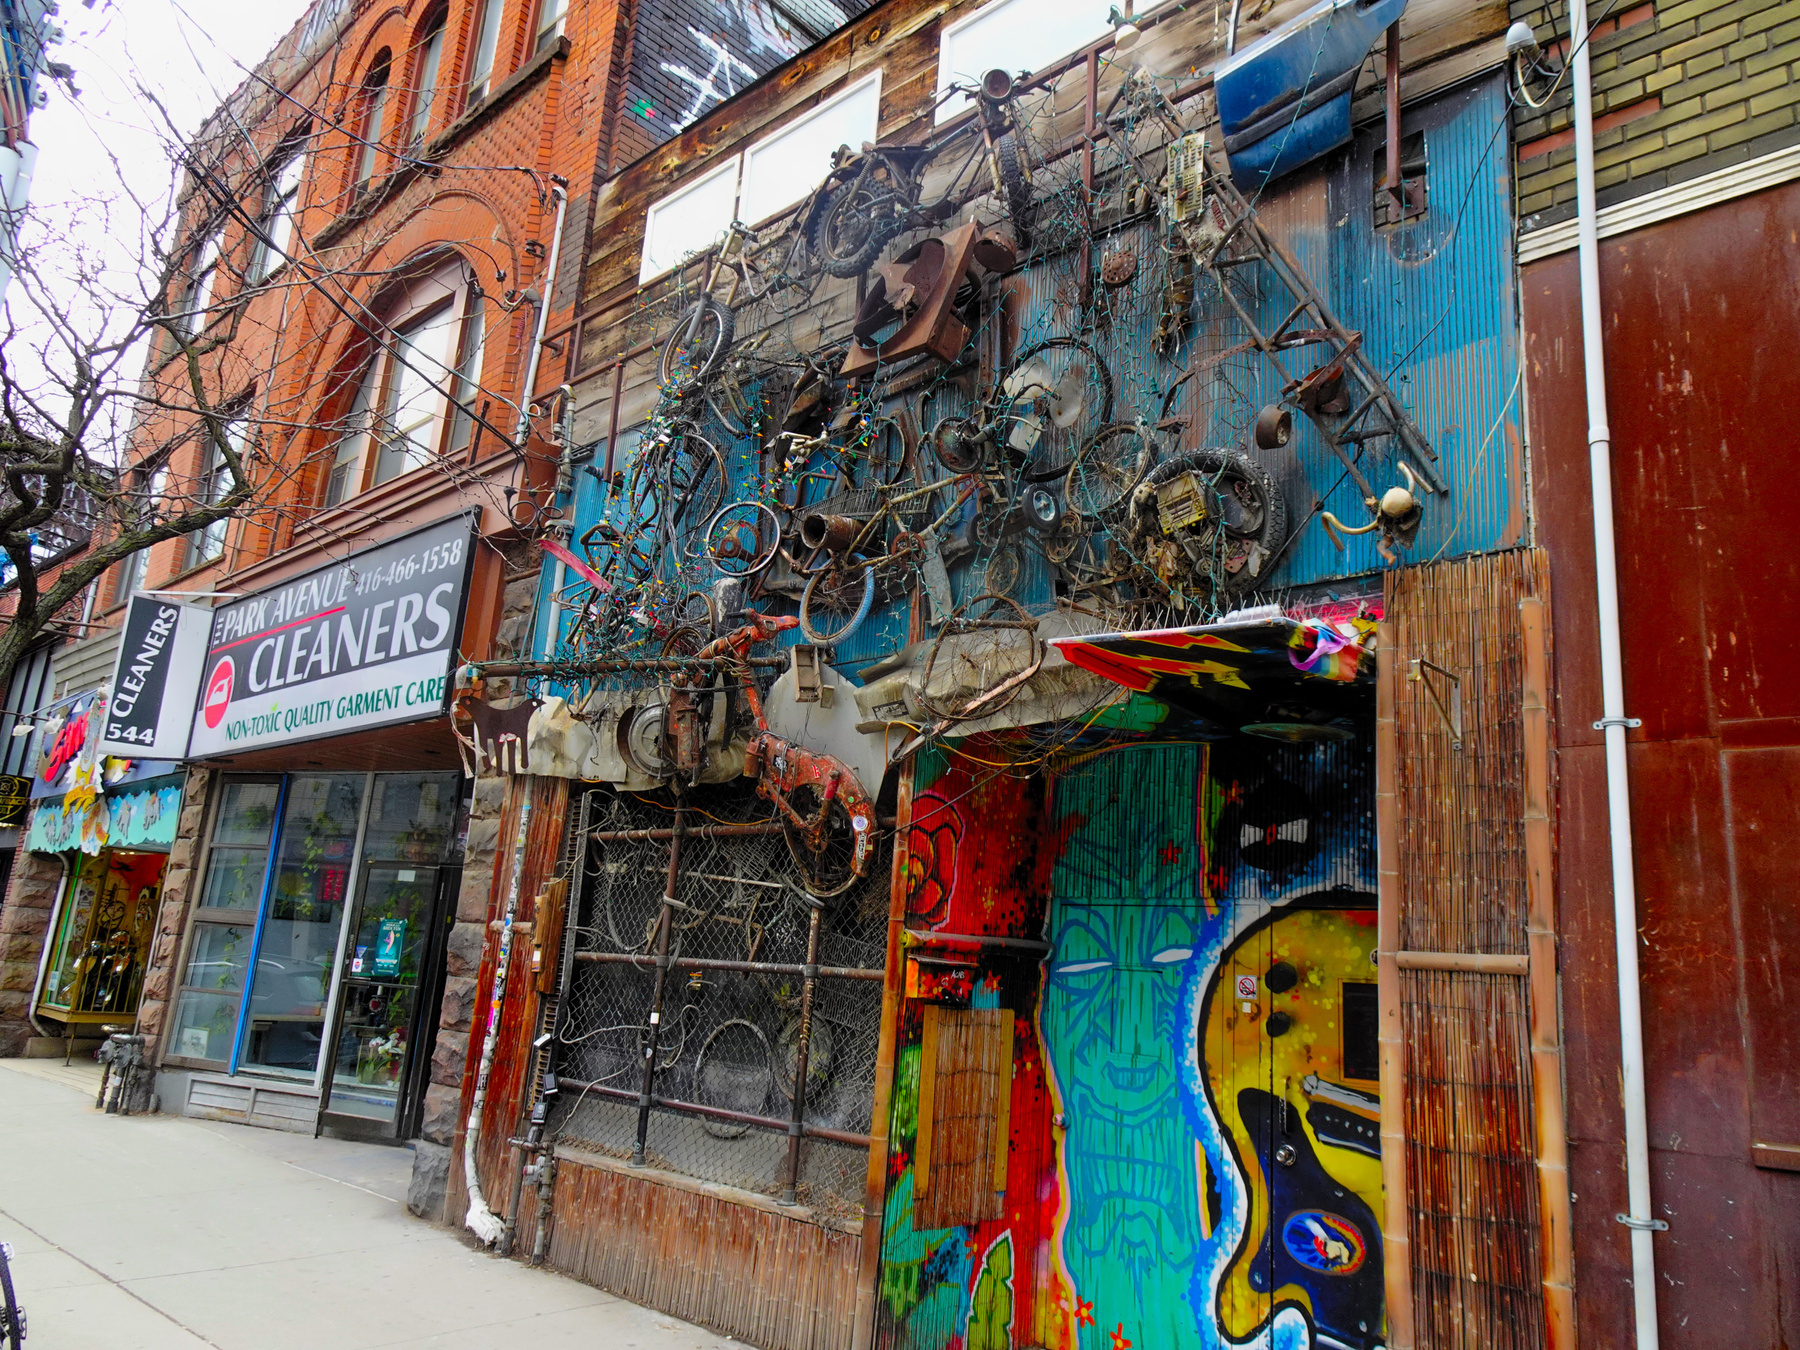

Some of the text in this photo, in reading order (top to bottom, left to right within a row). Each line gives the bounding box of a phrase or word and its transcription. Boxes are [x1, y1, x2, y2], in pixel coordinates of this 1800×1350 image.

[221, 597, 272, 643] PARK
[270, 564, 355, 627] AVENUE
[354, 538, 464, 597] 416-466-1558
[111, 605, 179, 718] CLEANERS
[248, 582, 454, 693] CLEANERS
[106, 723, 154, 745] 544
[225, 676, 446, 741] NON-TOXIC QUALITY GARMENT CARE
